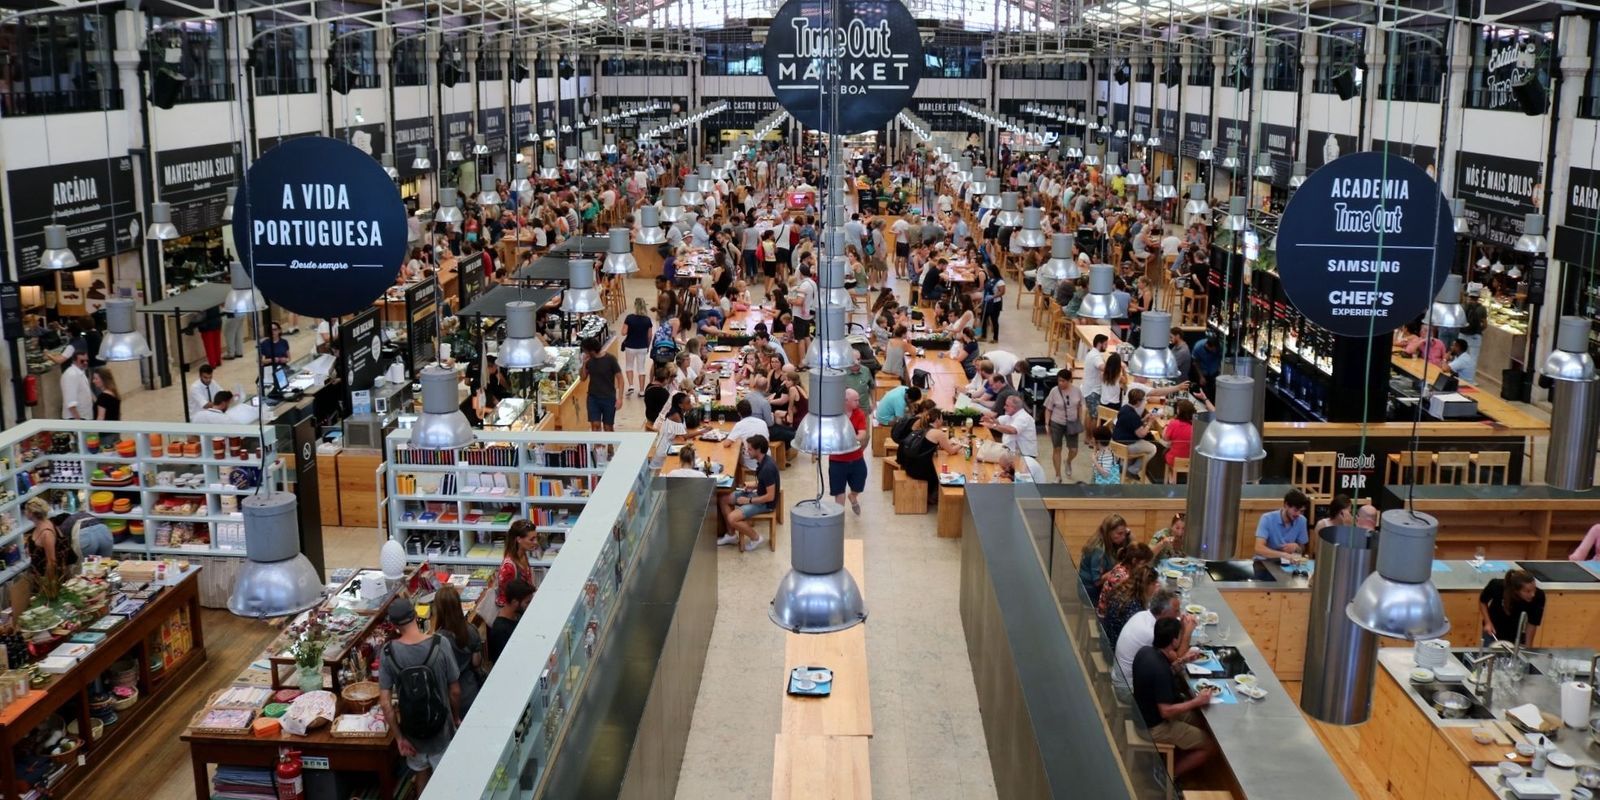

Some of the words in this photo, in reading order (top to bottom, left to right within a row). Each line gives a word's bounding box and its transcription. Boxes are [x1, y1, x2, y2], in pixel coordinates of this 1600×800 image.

[791, 17, 847, 57] Time
[848, 18, 892, 58] Out
[820, 85, 867, 95] LBOA
[918, 102, 947, 112] MARLENE
[164, 159, 215, 186] MANTEIGARIA
[1465, 164, 1480, 186] NÓS
[1487, 170, 1507, 191] MAIS
[1508, 174, 1533, 197] BOLOS
[53, 175, 98, 206] ARCÁDIA
[282, 184, 295, 209] A
[302, 184, 350, 210] VIDA
[1331, 177, 1409, 199] ACADEMIA
[1572, 184, 1599, 210] GARR
[1334, 202, 1371, 232] Time
[1372, 204, 1403, 233] Out
[253, 219, 383, 247] PORTUGUESA
[289, 259, 317, 270] Desde
[317, 261, 349, 271] sempre
[1327, 259, 1400, 273] SAMSUNG
[1328, 290, 1394, 306] CHEF'S
[1331, 307, 1388, 317] EXPERIENCE
[1338, 453, 1359, 468] Time
[1359, 453, 1375, 468] Out
[1342, 475, 1367, 488] BAR
